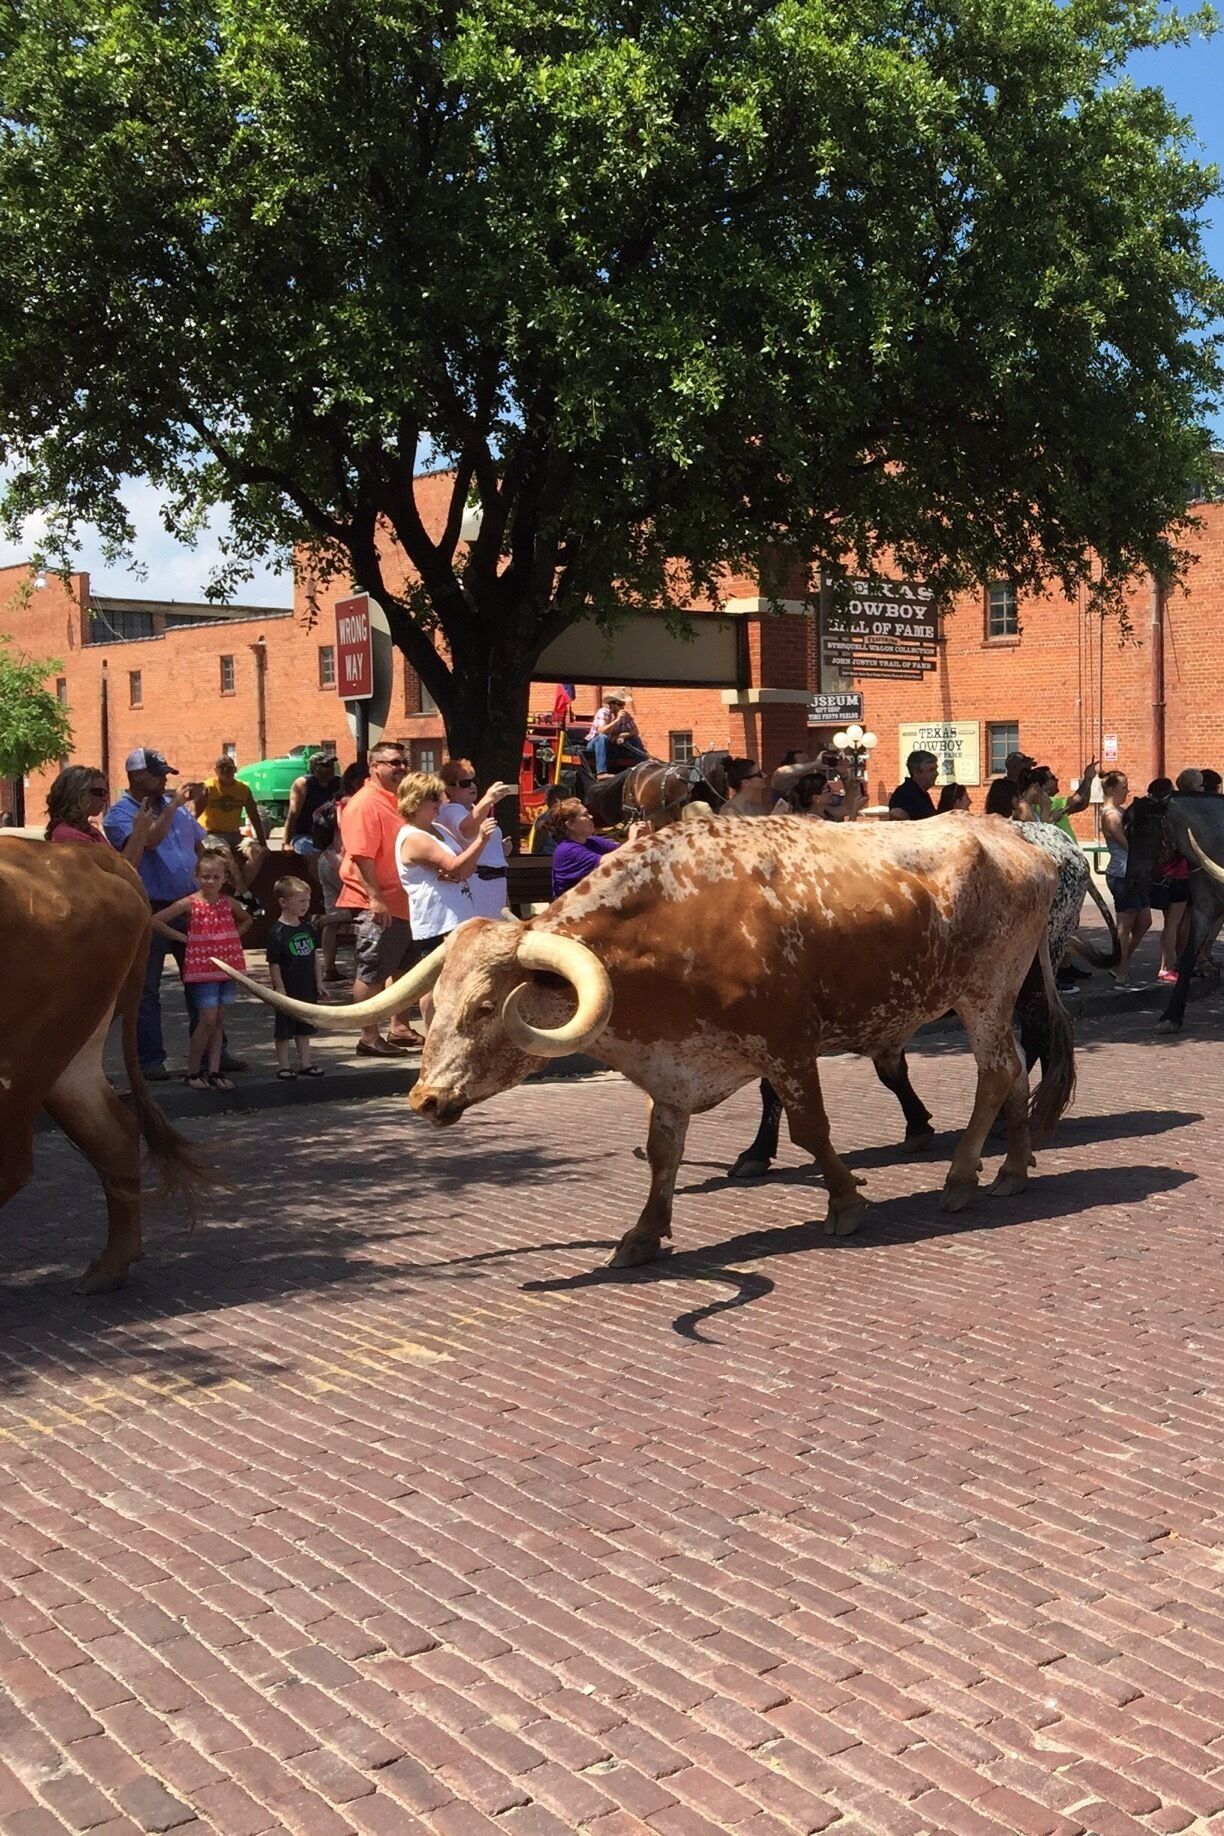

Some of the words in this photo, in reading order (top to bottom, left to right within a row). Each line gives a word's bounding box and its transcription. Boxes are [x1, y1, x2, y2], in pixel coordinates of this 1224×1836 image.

[836, 600, 928, 620] OWBOY
[339, 613, 367, 645] WRONG
[872, 622, 892, 635] OF
[894, 623, 935, 638] FAME
[895, 647, 935, 655] COLLECTION
[345, 652, 363, 682] WAY
[831, 657, 851, 665] JOHN
[851, 658, 878, 666] JUSTIN
[879, 660, 902, 668] TRAIL
[919, 727, 958, 739] TEXAS
[912, 740, 963, 752] COWBOY
